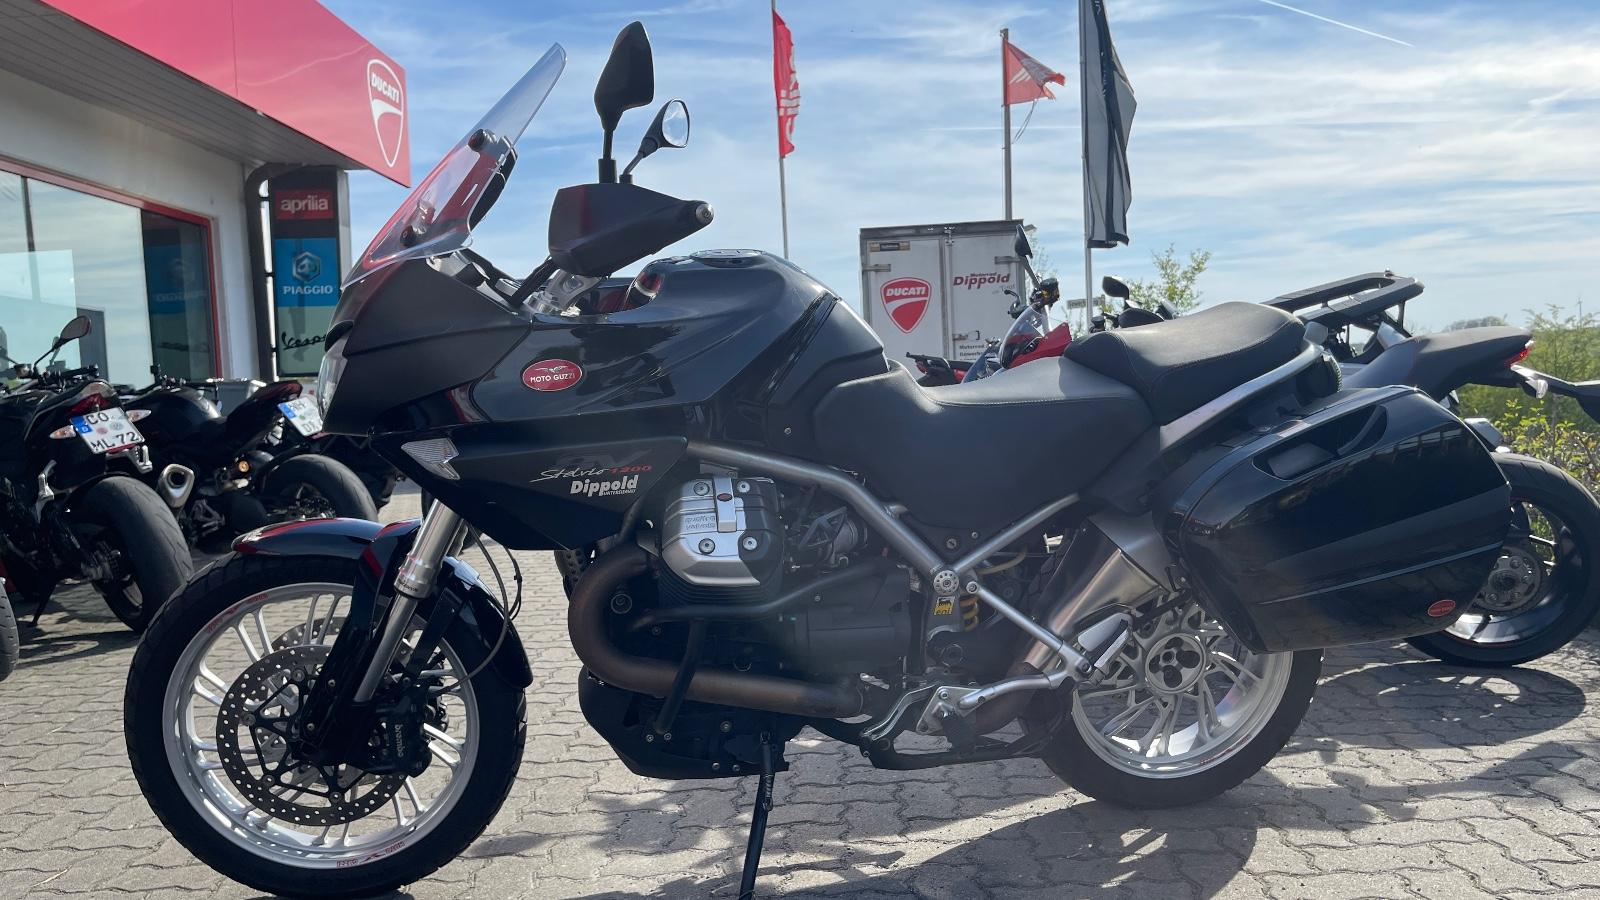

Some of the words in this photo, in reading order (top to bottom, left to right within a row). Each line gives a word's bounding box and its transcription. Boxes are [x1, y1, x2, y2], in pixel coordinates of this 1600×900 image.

[371, 72, 399, 103] DUCATI
[281, 195, 328, 213] aprilia
[283, 285, 333, 295] PIAGGIO
[953, 273, 1010, 290] Dippold
[886, 286, 926, 297] DUCATI
[281, 331, 327, 350] Vesp
[530, 375, 552, 383] MOTO
[553, 373, 575, 381] GUZZI
[86, 412, 109, 425] CO
[529, 467, 609, 482] Stelvio
[608, 464, 653, 474] 1200
[570, 475, 639, 497] Dippold
[394, 725, 405, 757] brembo
